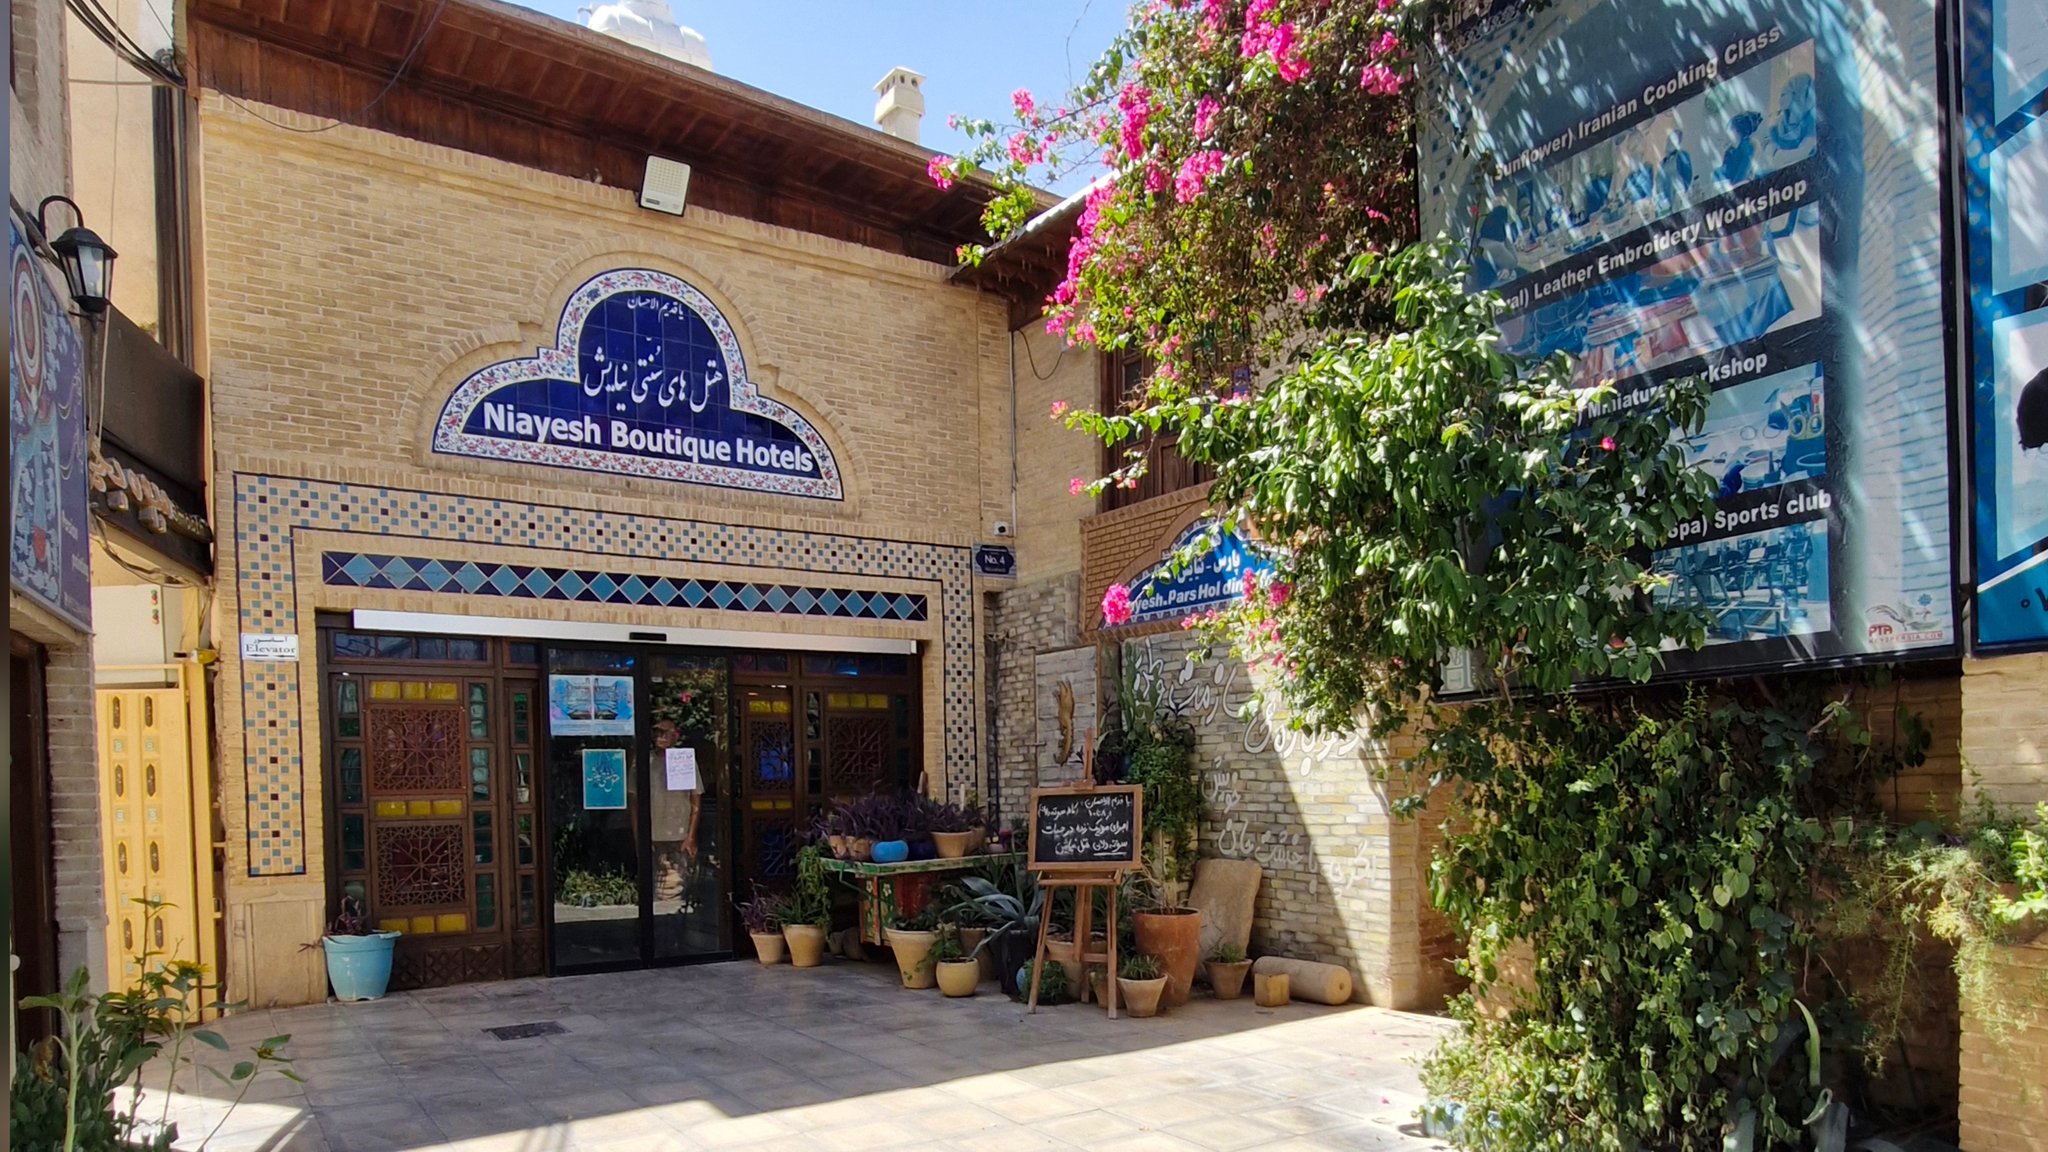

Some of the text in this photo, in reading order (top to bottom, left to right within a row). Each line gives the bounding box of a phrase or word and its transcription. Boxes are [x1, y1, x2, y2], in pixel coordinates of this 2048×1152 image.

[1578, 98, 1637, 140] Iranian
[1643, 56, 1718, 106] Cooking
[1725, 27, 1780, 63] Class
[1534, 265, 1592, 299] Leather
[1597, 223, 1701, 275] Embroidery
[1706, 179, 1808, 231] Workshop
[658, 301, 679, 323] قدیم
[583, 346, 629, 412] نیایش
[657, 371, 687, 408] های
[689, 359, 724, 413] هتل
[483, 402, 814, 474] Niayesh Boutique Hotels
[1713, 503, 1780, 533] Sports
[1786, 489, 1832, 516] club
[999, 556, 1005, 565] 4
[1222, 577, 1244, 595] din
[245, 644, 297, 654] Elevator
[1218, 818, 1256, 856] جان
[1254, 829, 1305, 866] خشت
